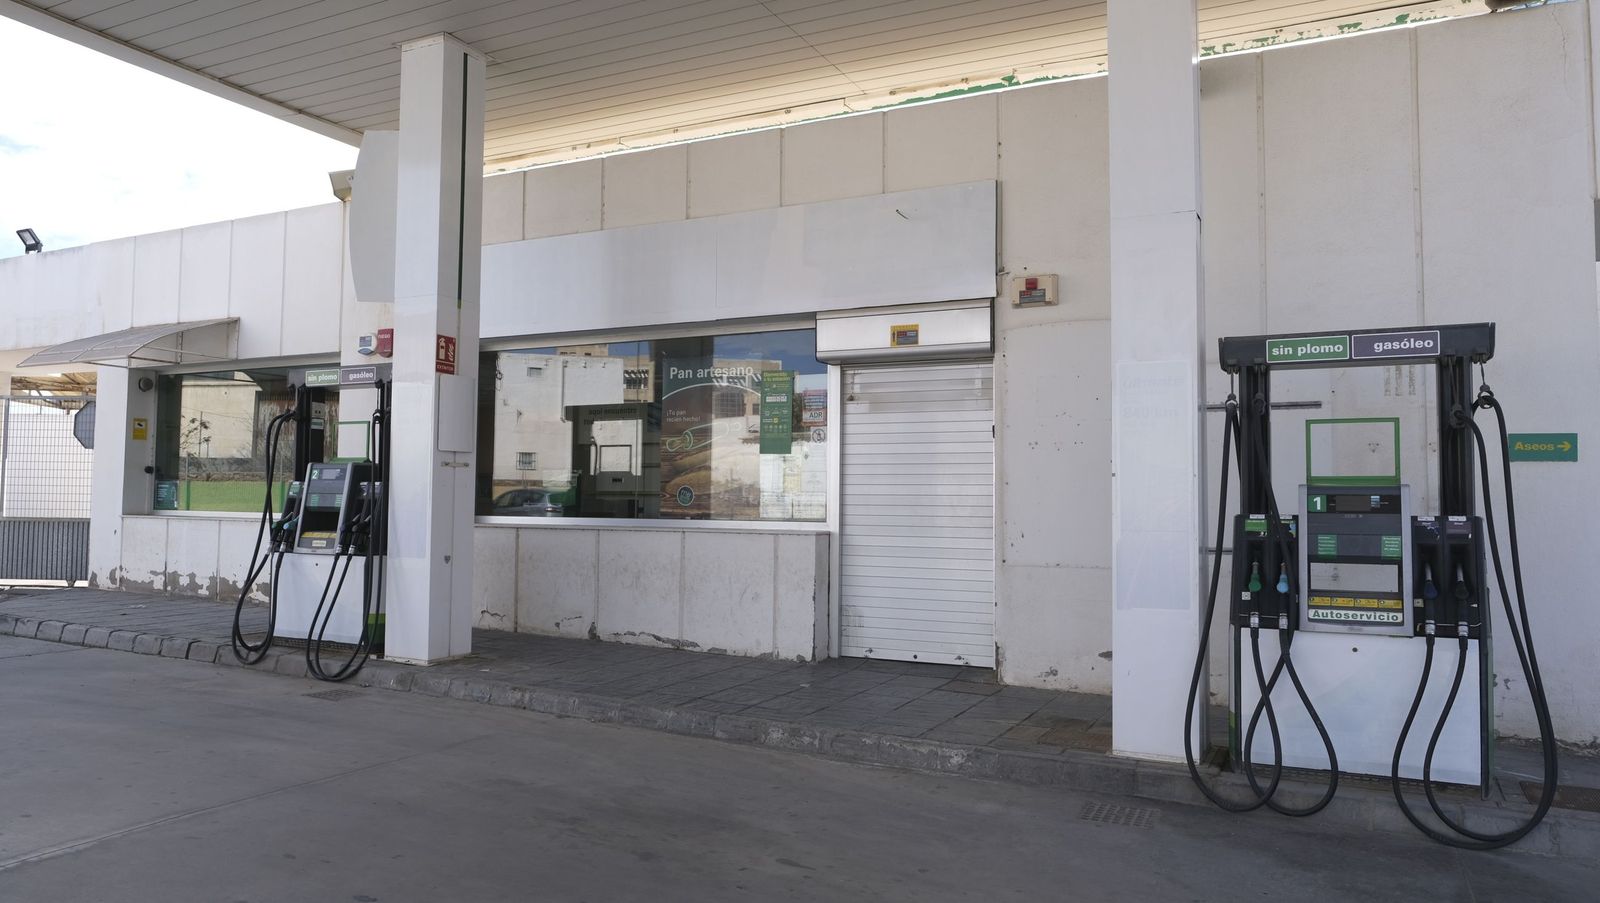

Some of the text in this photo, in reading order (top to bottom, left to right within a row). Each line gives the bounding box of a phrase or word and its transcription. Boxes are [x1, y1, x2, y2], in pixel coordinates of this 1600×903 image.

[1271, 344, 1343, 357] sin plomo
[1373, 338, 1434, 353] gasóleo
[318, 373, 338, 382] plomo
[349, 371, 374, 381] gasóleo
[670, 366, 753, 380] Pan artesano
[809, 411, 823, 419] ADR
[1514, 441, 1555, 451] Aseos
[312, 470, 319, 479] 2
[1313, 496, 1321, 511] 1
[1312, 609, 1399, 622] Autoservicio
